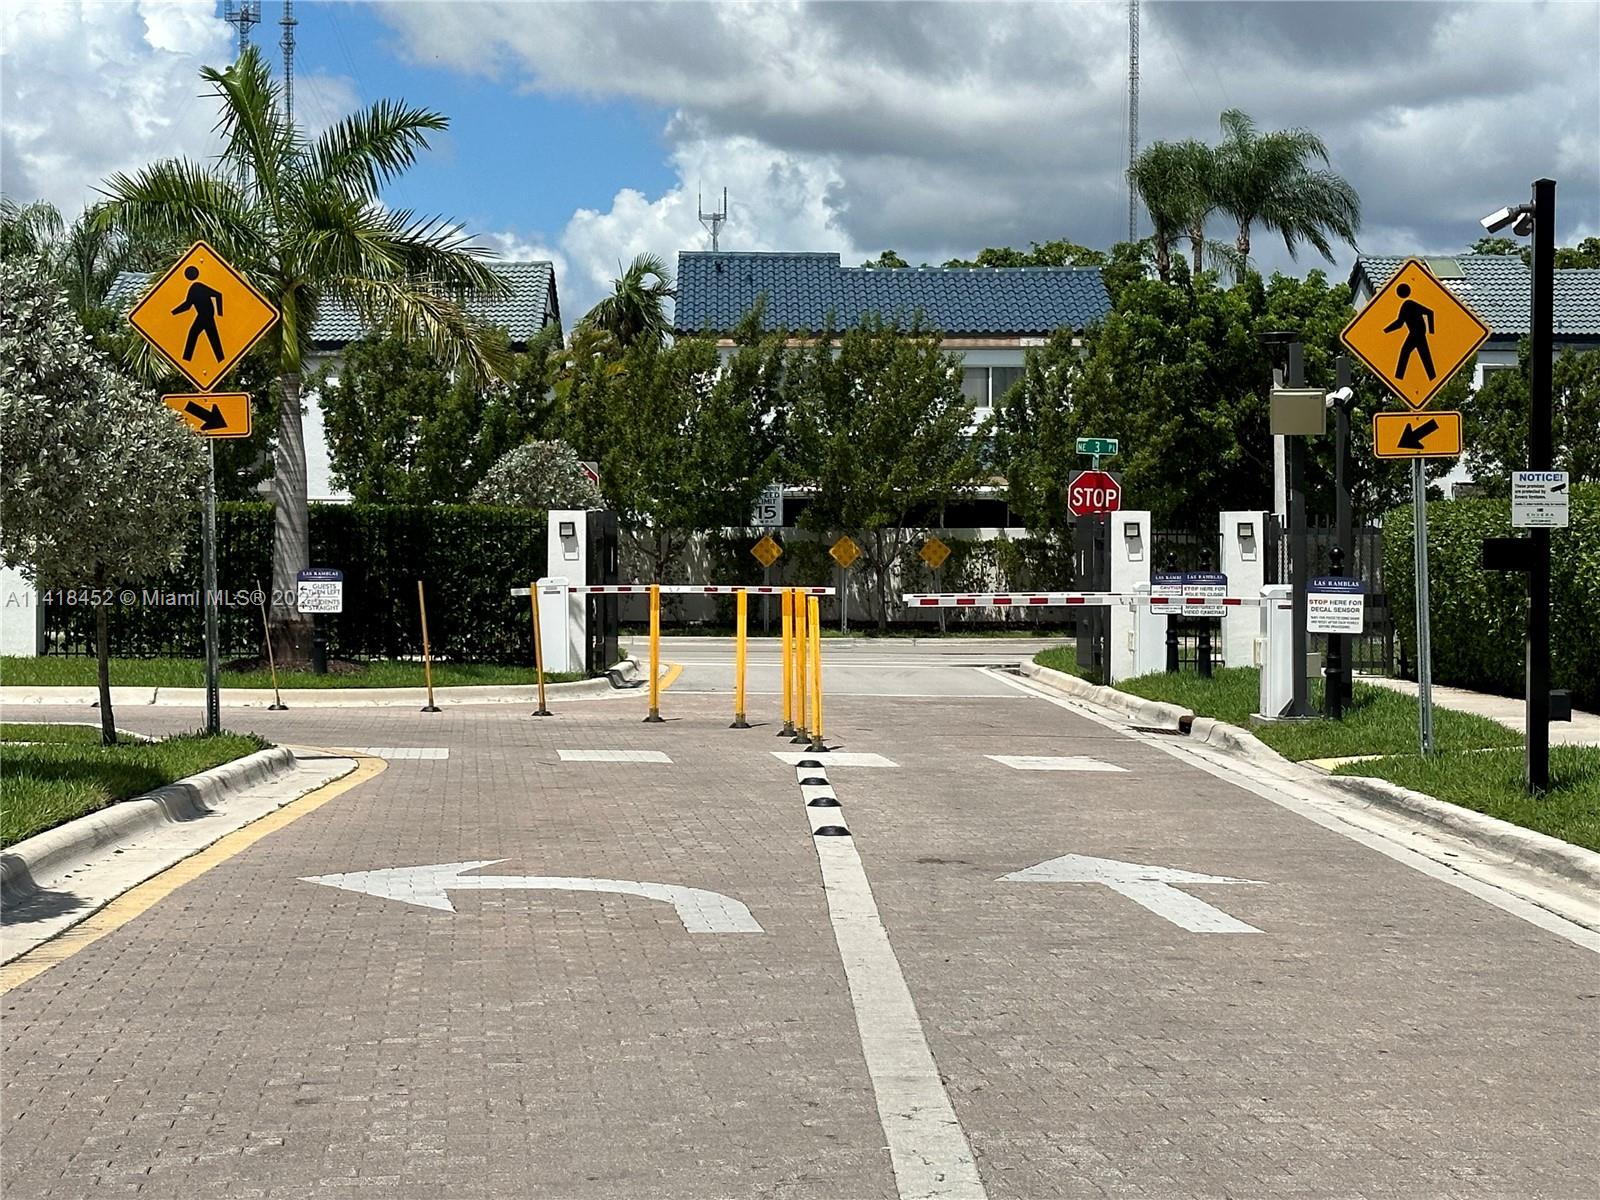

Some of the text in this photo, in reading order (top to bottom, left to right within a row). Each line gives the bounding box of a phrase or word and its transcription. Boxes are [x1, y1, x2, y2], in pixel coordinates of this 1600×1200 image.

[1078, 441, 1116, 453] NE 3 PL
[1519, 473, 1563, 482] NOTICE!
[1072, 487, 1117, 508] STOP
[756, 505, 777, 520] 15
